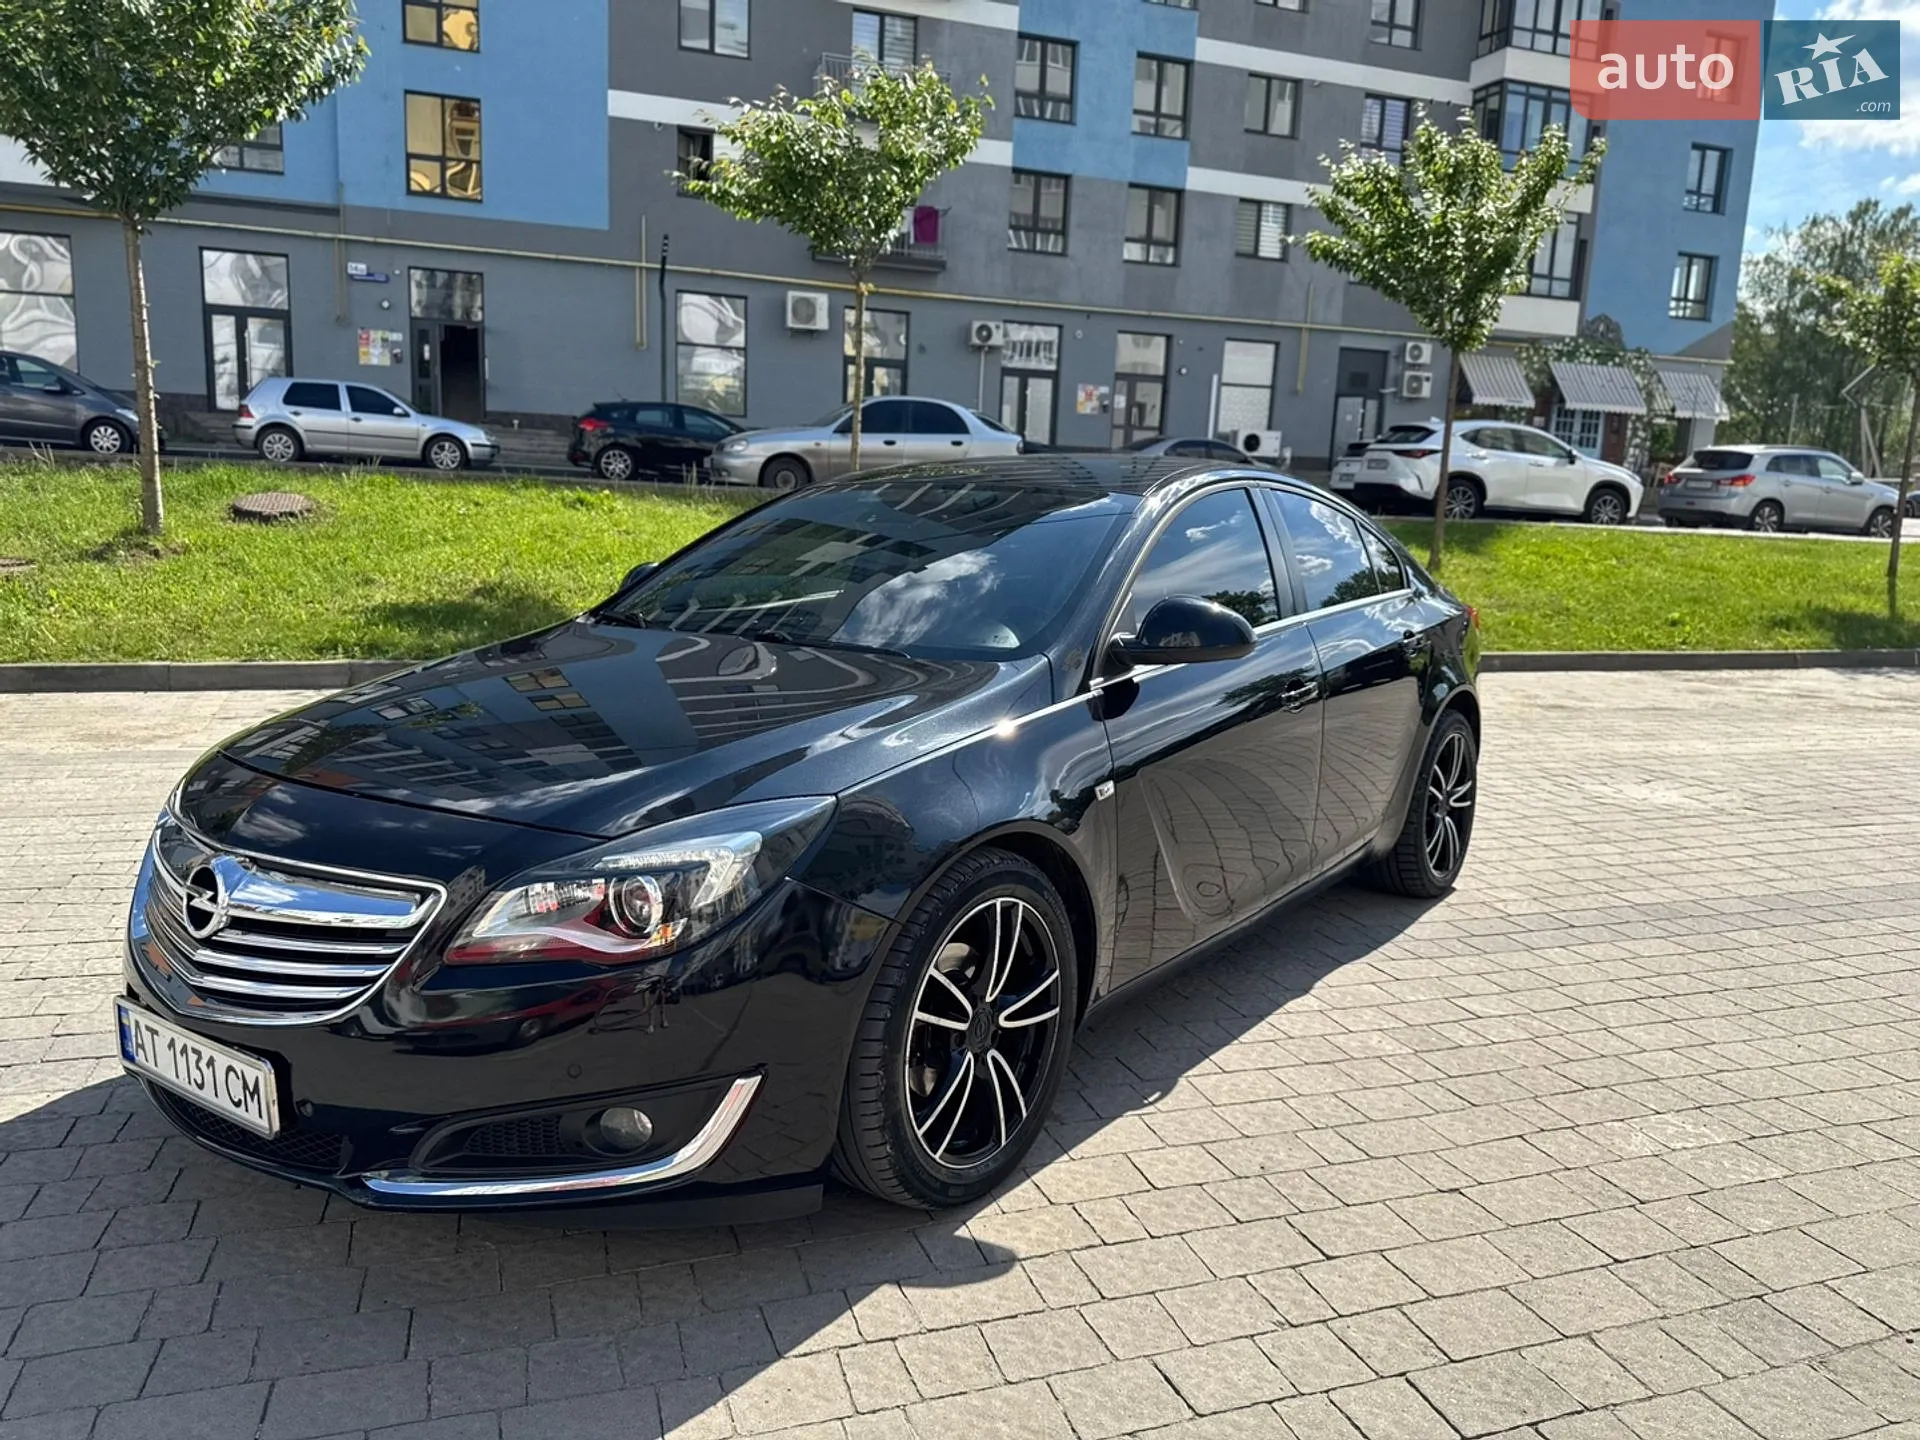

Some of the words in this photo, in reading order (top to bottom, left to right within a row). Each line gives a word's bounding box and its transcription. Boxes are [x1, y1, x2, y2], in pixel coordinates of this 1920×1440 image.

[134, 1020, 159, 1068] AT
[167, 1037, 218, 1098] 1131
[225, 1065, 263, 1119] CM
